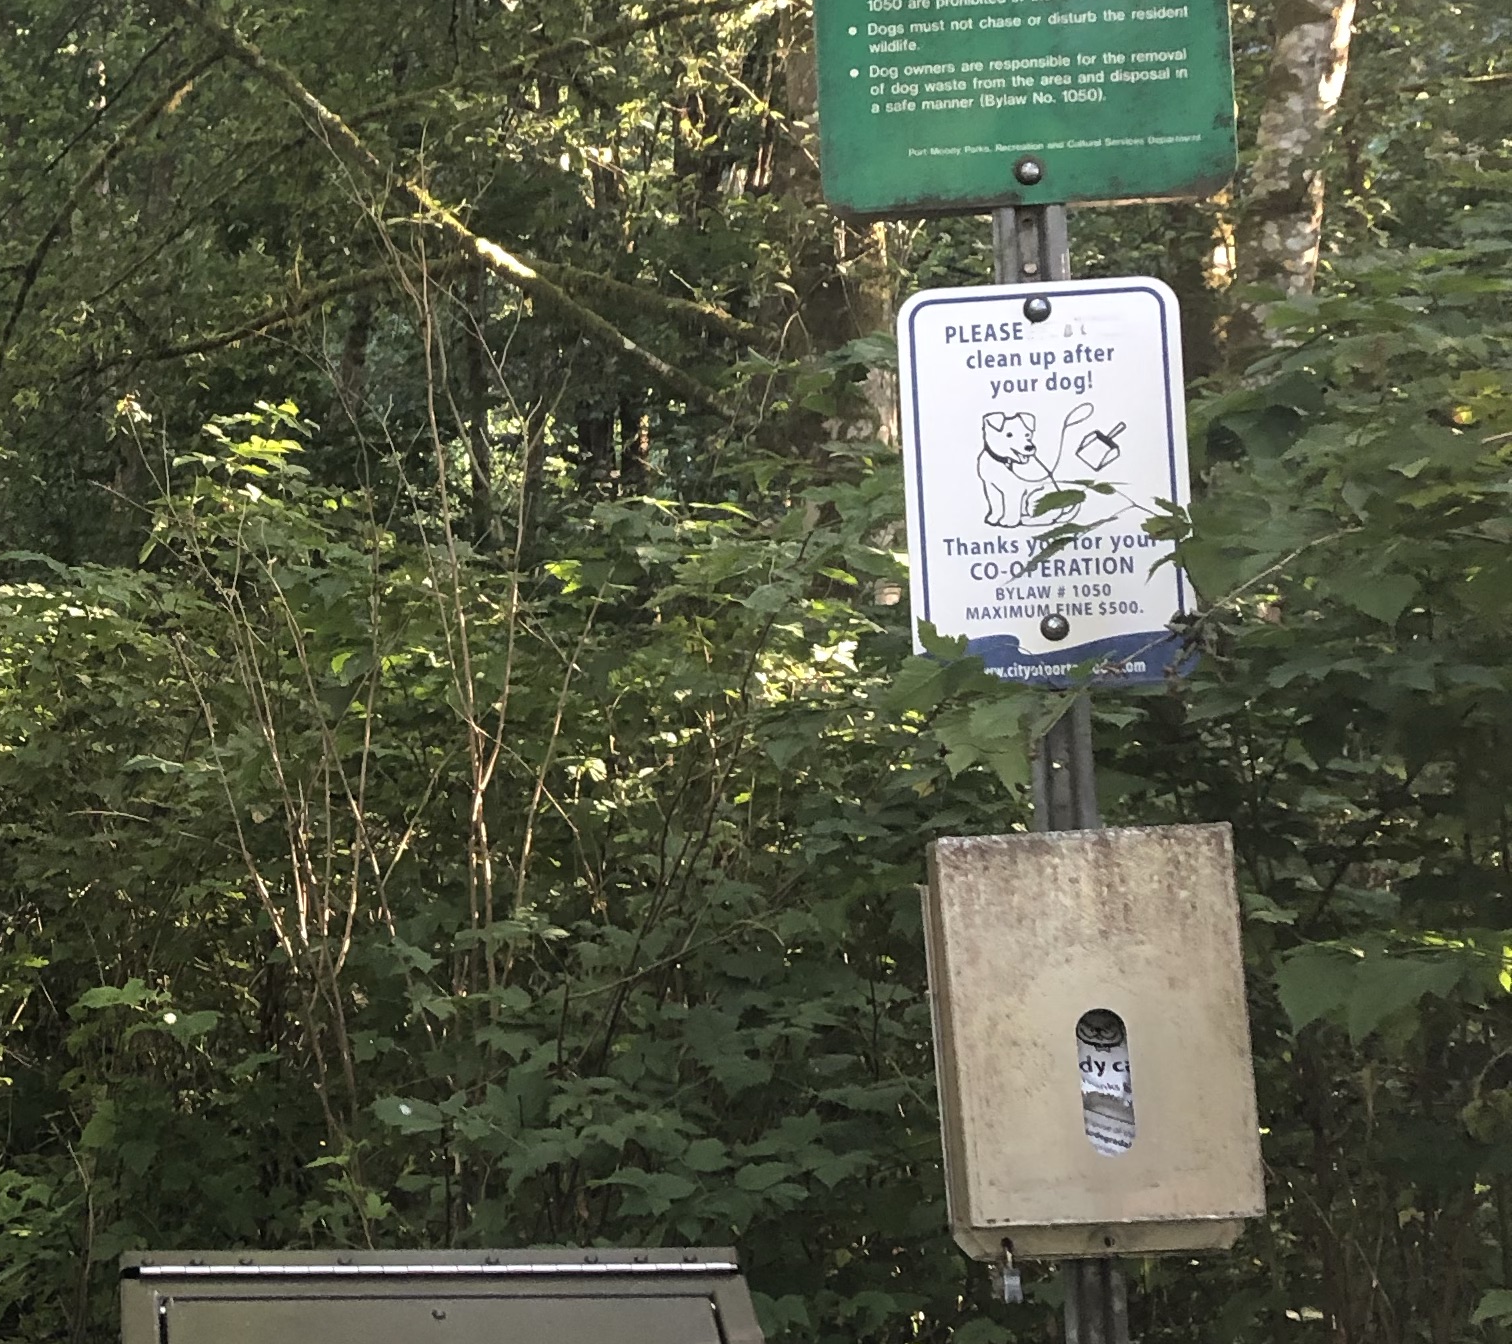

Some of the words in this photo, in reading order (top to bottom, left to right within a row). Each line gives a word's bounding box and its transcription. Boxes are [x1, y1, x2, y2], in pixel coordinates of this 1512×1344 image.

[867, 0, 902, 12] 1050
[867, 23, 905, 37] Dogs
[910, 20, 944, 33] must
[950, 18, 973, 31] not
[979, 16, 1022, 29] chase
[1028, 15, 1042, 27] or
[1048, 10, 1097, 25] disturb
[1103, 8, 1126, 21] the
[1131, 6, 1188, 20] resident
[869, 39, 921, 53] wildlife.
[869, 65, 899, 80] Dog
[904, 62, 955, 75] owners
[961, 60, 984, 72] are
[989, 55, 1071, 72] responsible
[1077, 53, 1097, 65] for
[1103, 52, 1126, 64] the
[1131, 48, 1188, 62] removal
[870, 83, 884, 95] of
[891, 81, 919, 97] dog
[925, 78, 968, 91] waste
[973, 76, 1006, 89] from
[1012, 75, 1034, 87] the
[1041, 73, 1072, 85] area
[1078, 71, 1105, 84] and
[1110, 66, 1170, 83] disposal
[1176, 66, 1188, 78] in
[871, 103, 880, 113] a
[886, 100, 916, 112] safe
[922, 97, 974, 110] manner
[980, 93, 1027, 108] (Bylaw
[1033, 91, 1057, 104] No.
[1063, 88, 1107, 103] 1050).
[909, 147, 927, 157] Port
[995, 142, 1044, 152] Recreation
[1105, 136, 1144, 146] Services
[945, 322, 1023, 344] PLEASE
[966, 350, 1022, 369] clean
[1030, 351, 1056, 369] up
[1063, 344, 1114, 363] after
[990, 378, 1038, 399] your
[1046, 370, 1092, 394] dog!
[943, 536, 1019, 556] Thanks
[996, 586, 1051, 601] BYLAW
[1057, 588, 1065, 598] #
[1073, 584, 1111, 597] 1050
[966, 605, 1050, 621] MAXIMUM
[1057, 603, 1093, 616] FINE
[1099, 601, 1144, 615] $500.
